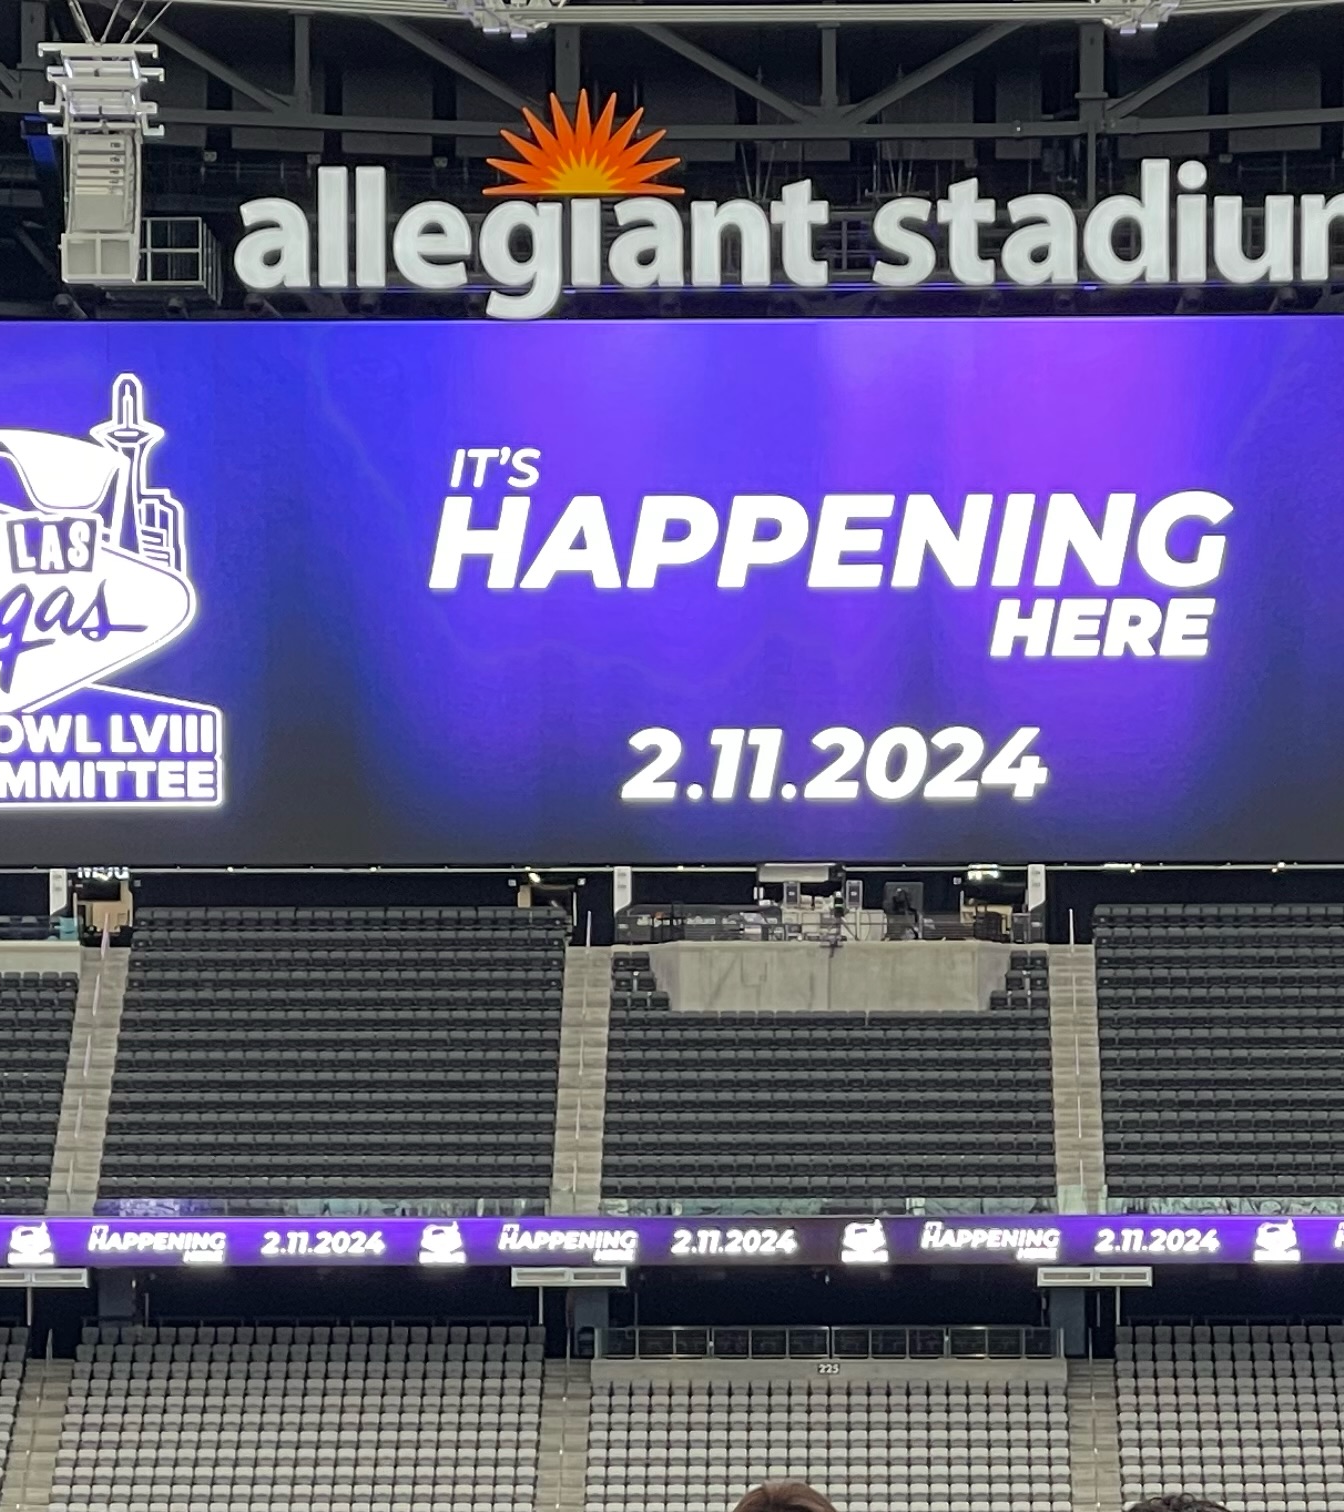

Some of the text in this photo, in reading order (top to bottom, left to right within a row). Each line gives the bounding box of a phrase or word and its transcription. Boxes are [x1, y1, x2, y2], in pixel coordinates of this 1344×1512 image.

[234, 165, 829, 320] allegiant
[14, 520, 94, 572] LAS
[428, 490, 1234, 591] HAPPENING
[989, 597, 1213, 659] HERE
[110, 713, 216, 755] LVIII
[621, 726, 1048, 800] 2.11.2024
[262, 1232, 384, 1254] 2.11.2024
[672, 1230, 796, 1253] 2.11.2024
[1095, 1229, 1219, 1252] 2.11.2024
[818, 1364, 840, 1373] 225
